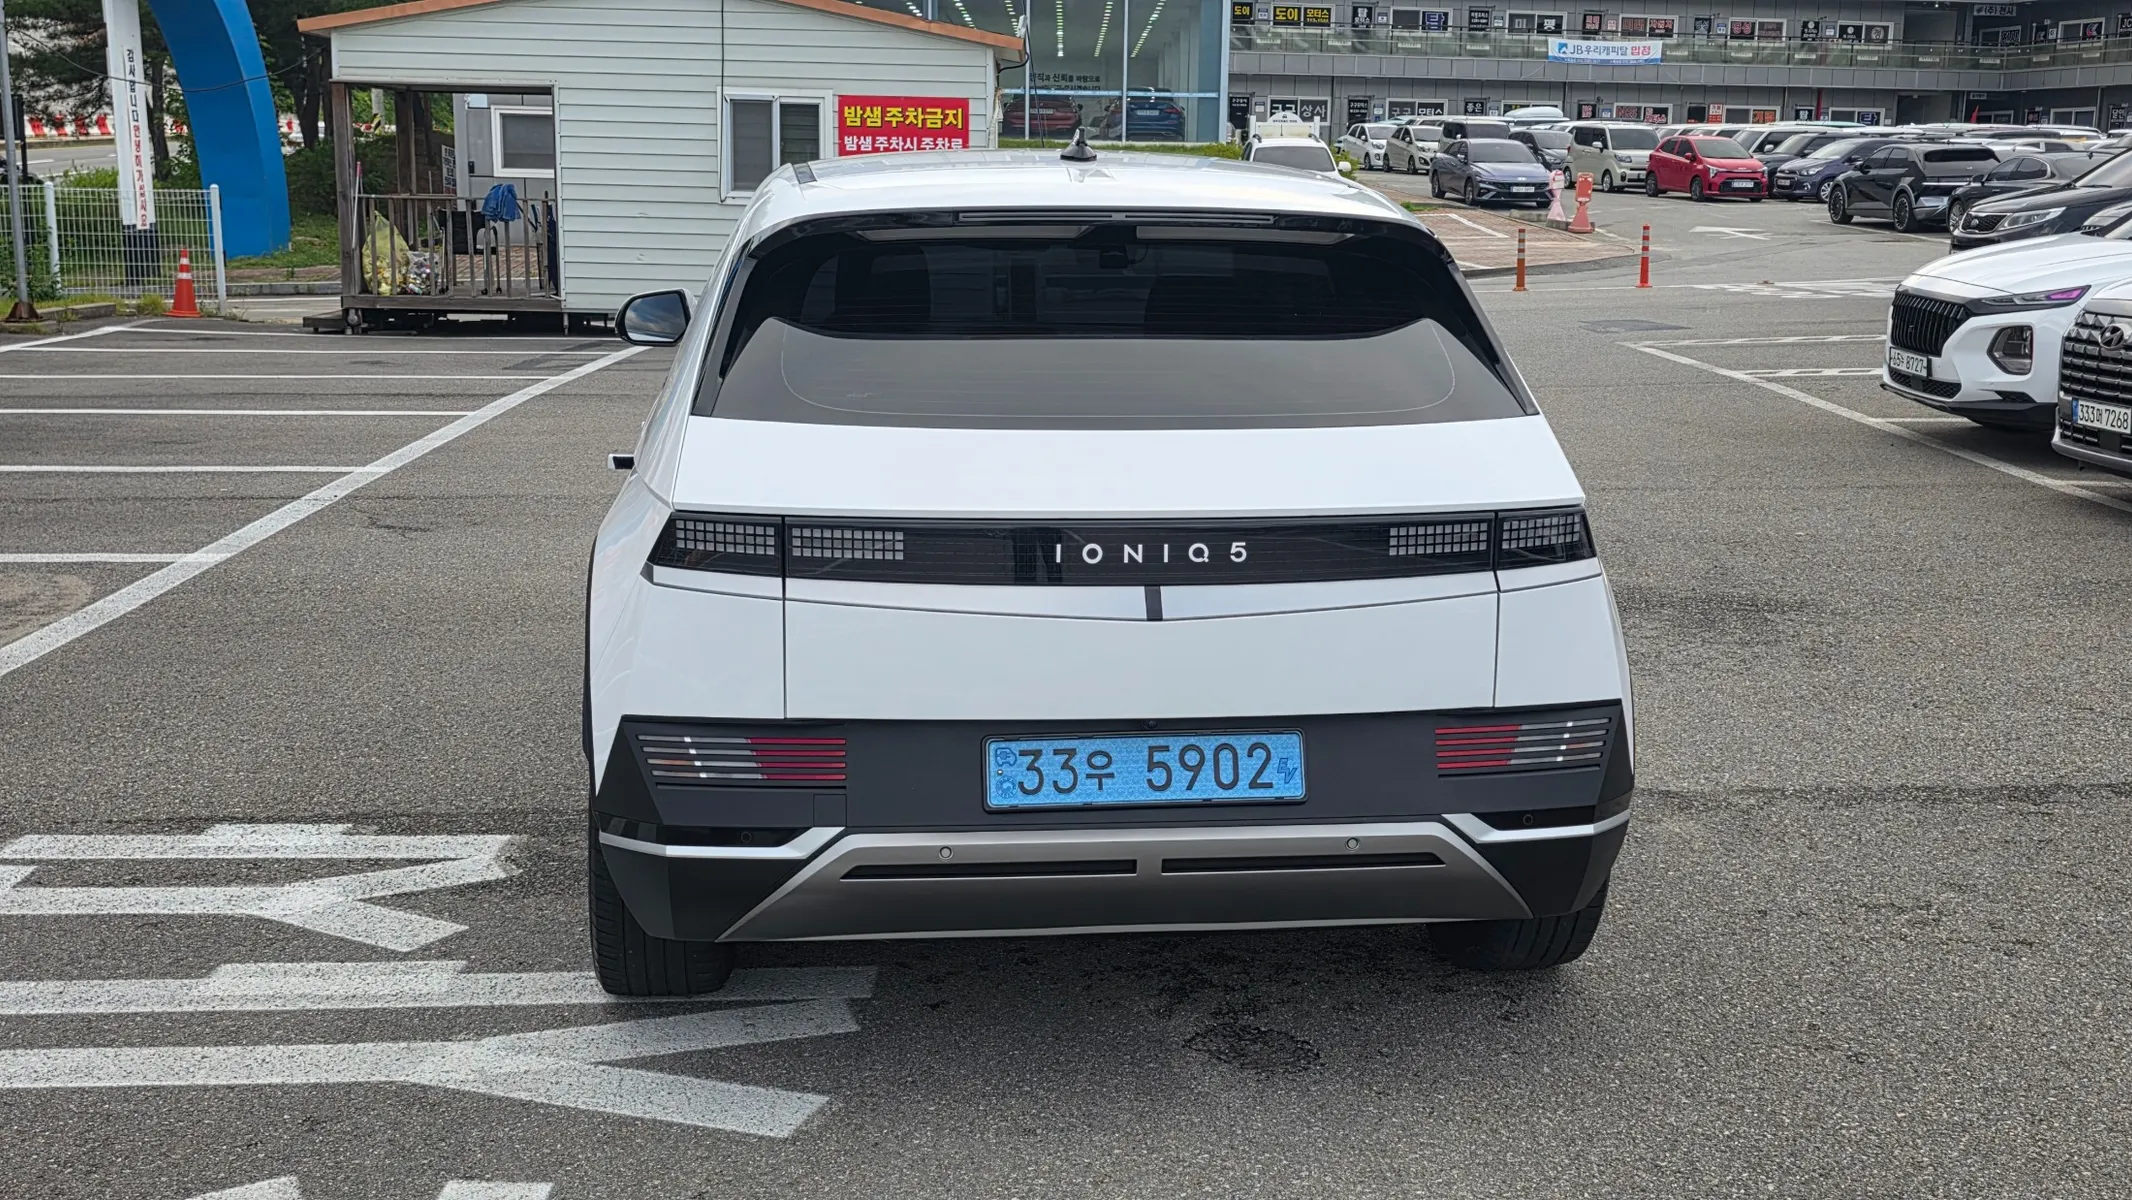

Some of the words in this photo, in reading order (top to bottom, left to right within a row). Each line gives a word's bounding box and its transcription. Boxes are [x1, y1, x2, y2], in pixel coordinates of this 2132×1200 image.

[1234, 6, 1250, 15] 도이
[1275, 8, 1298, 20] 도이
[1306, 9, 1329, 18] 모터스
[1984, 6, 1997, 15] (주)
[1569, 44, 1628, 56] JB우리캐피탈
[1630, 45, 1651, 56] 입점
[127, 49, 139, 122] 감사합니다
[1301, 104, 1326, 118] 상사
[1466, 102, 1482, 113] 좋은
[844, 105, 882, 127] 밤샘
[885, 107, 964, 129] 주차금지
[844, 135, 872, 151] 밤샘
[875, 136, 917, 151] 주차시
[1906, 354, 1924, 373] 8727
[2104, 409, 2129, 430] 7268
[1056, 543, 1209, 564] IONIQ
[1230, 541, 1247, 563] 5
[1017, 748, 1115, 795] 33우
[1146, 743, 1274, 791] 5902
[1277, 757, 1297, 784] EV
